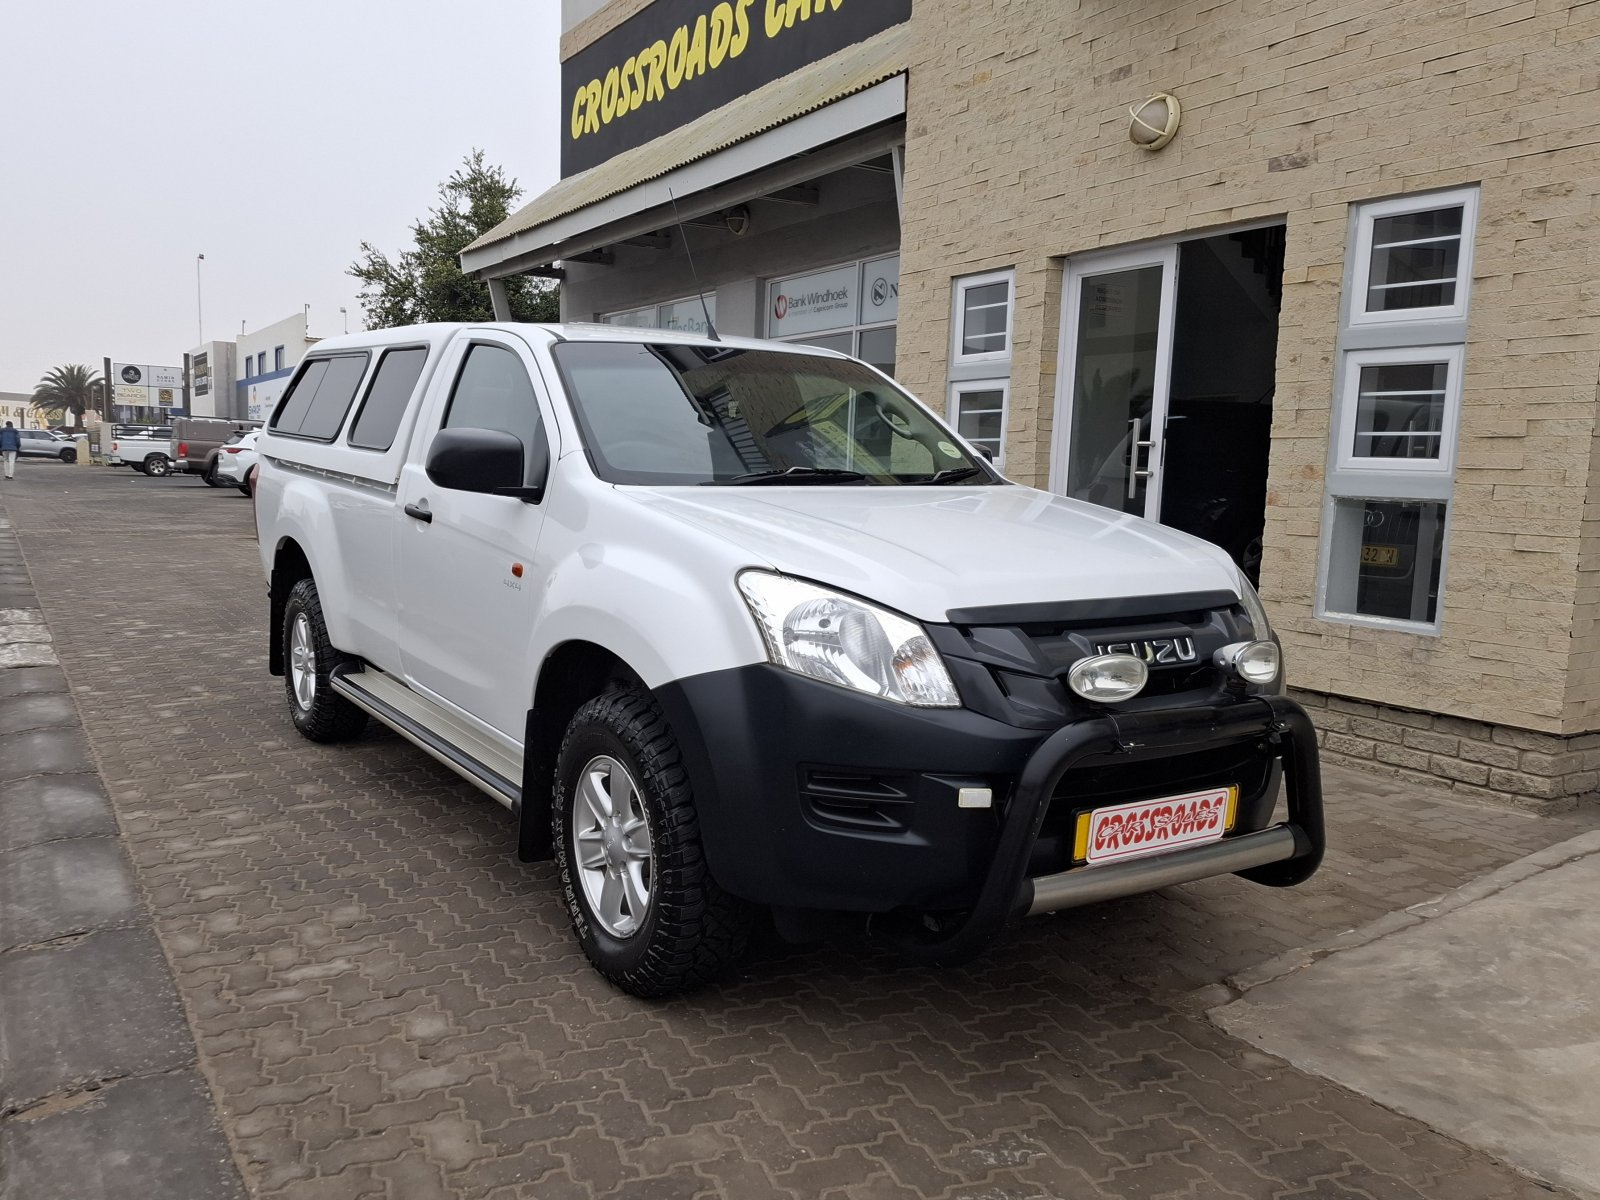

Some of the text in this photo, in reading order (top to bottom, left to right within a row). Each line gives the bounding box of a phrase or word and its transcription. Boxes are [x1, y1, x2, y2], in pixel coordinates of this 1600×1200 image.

[571, 0, 754, 139] CROSSROADS
[788, 286, 849, 309] Bank Windhoek
[1094, 796, 1224, 851] CROSSROADS
[1098, 807, 1220, 838] CAR SALES
